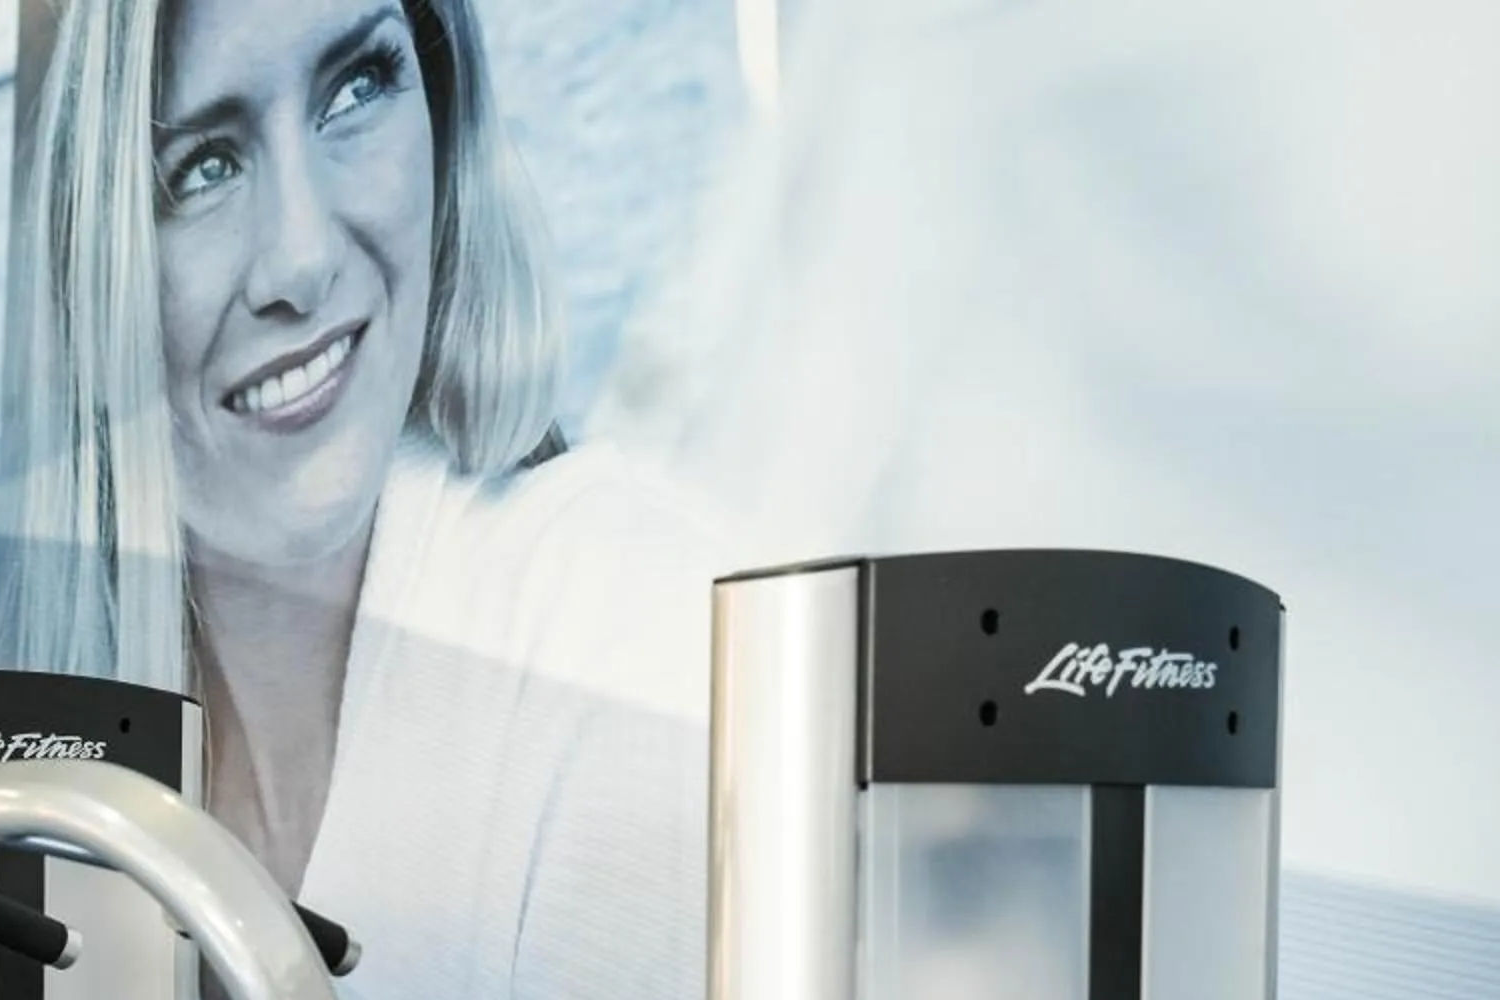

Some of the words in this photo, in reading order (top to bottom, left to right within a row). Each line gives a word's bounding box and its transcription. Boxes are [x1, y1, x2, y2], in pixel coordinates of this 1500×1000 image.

[1023, 642, 1113, 697] Life
[1105, 647, 1218, 698] Fitness
[1, 732, 107, 763] Fitness
